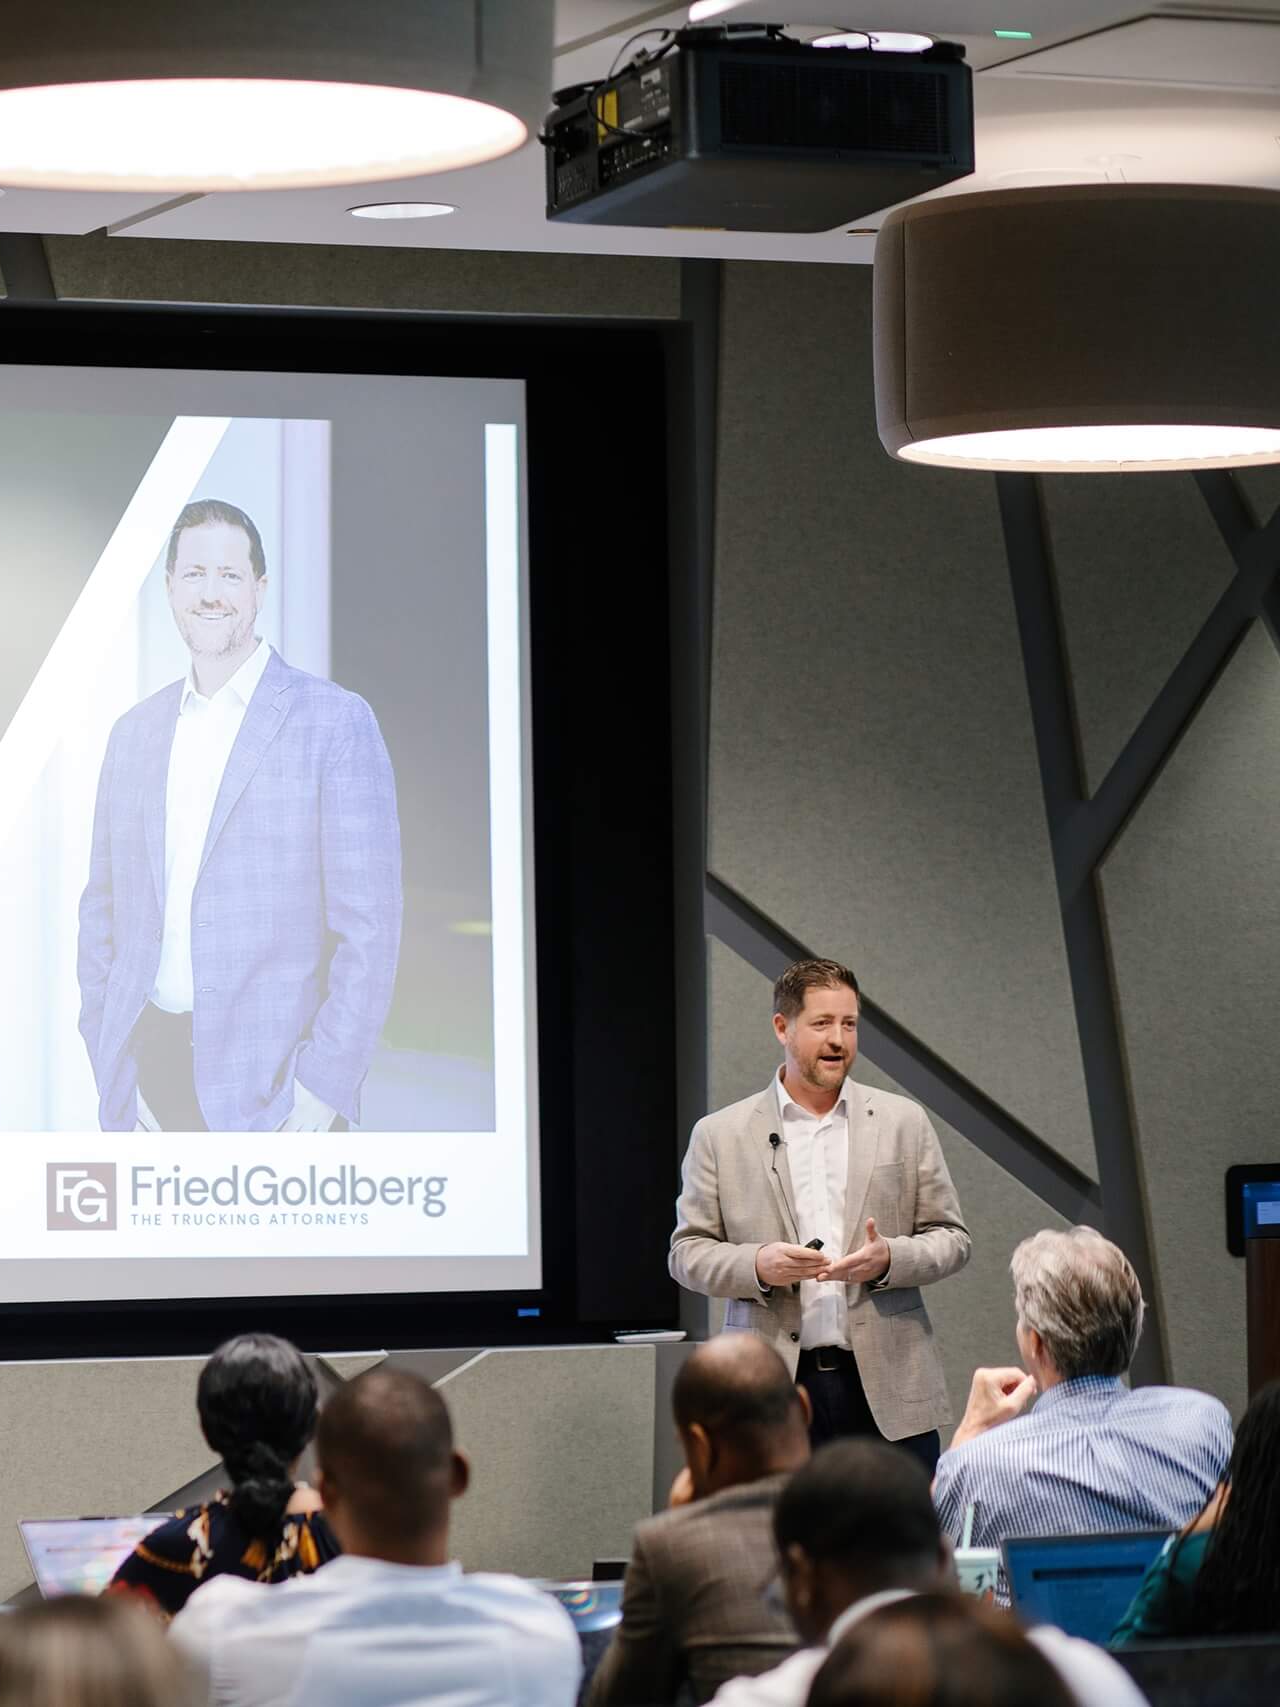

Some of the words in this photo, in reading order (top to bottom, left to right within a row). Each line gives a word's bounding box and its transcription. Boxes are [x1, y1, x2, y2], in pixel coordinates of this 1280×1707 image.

[54, 1169, 109, 1224] FG
[131, 1164, 449, 1218] FriedGoldberg
[131, 1213, 161, 1226] THE
[172, 1213, 260, 1226] TRUCKING
[269, 1212, 369, 1226] ATTORNEYS
